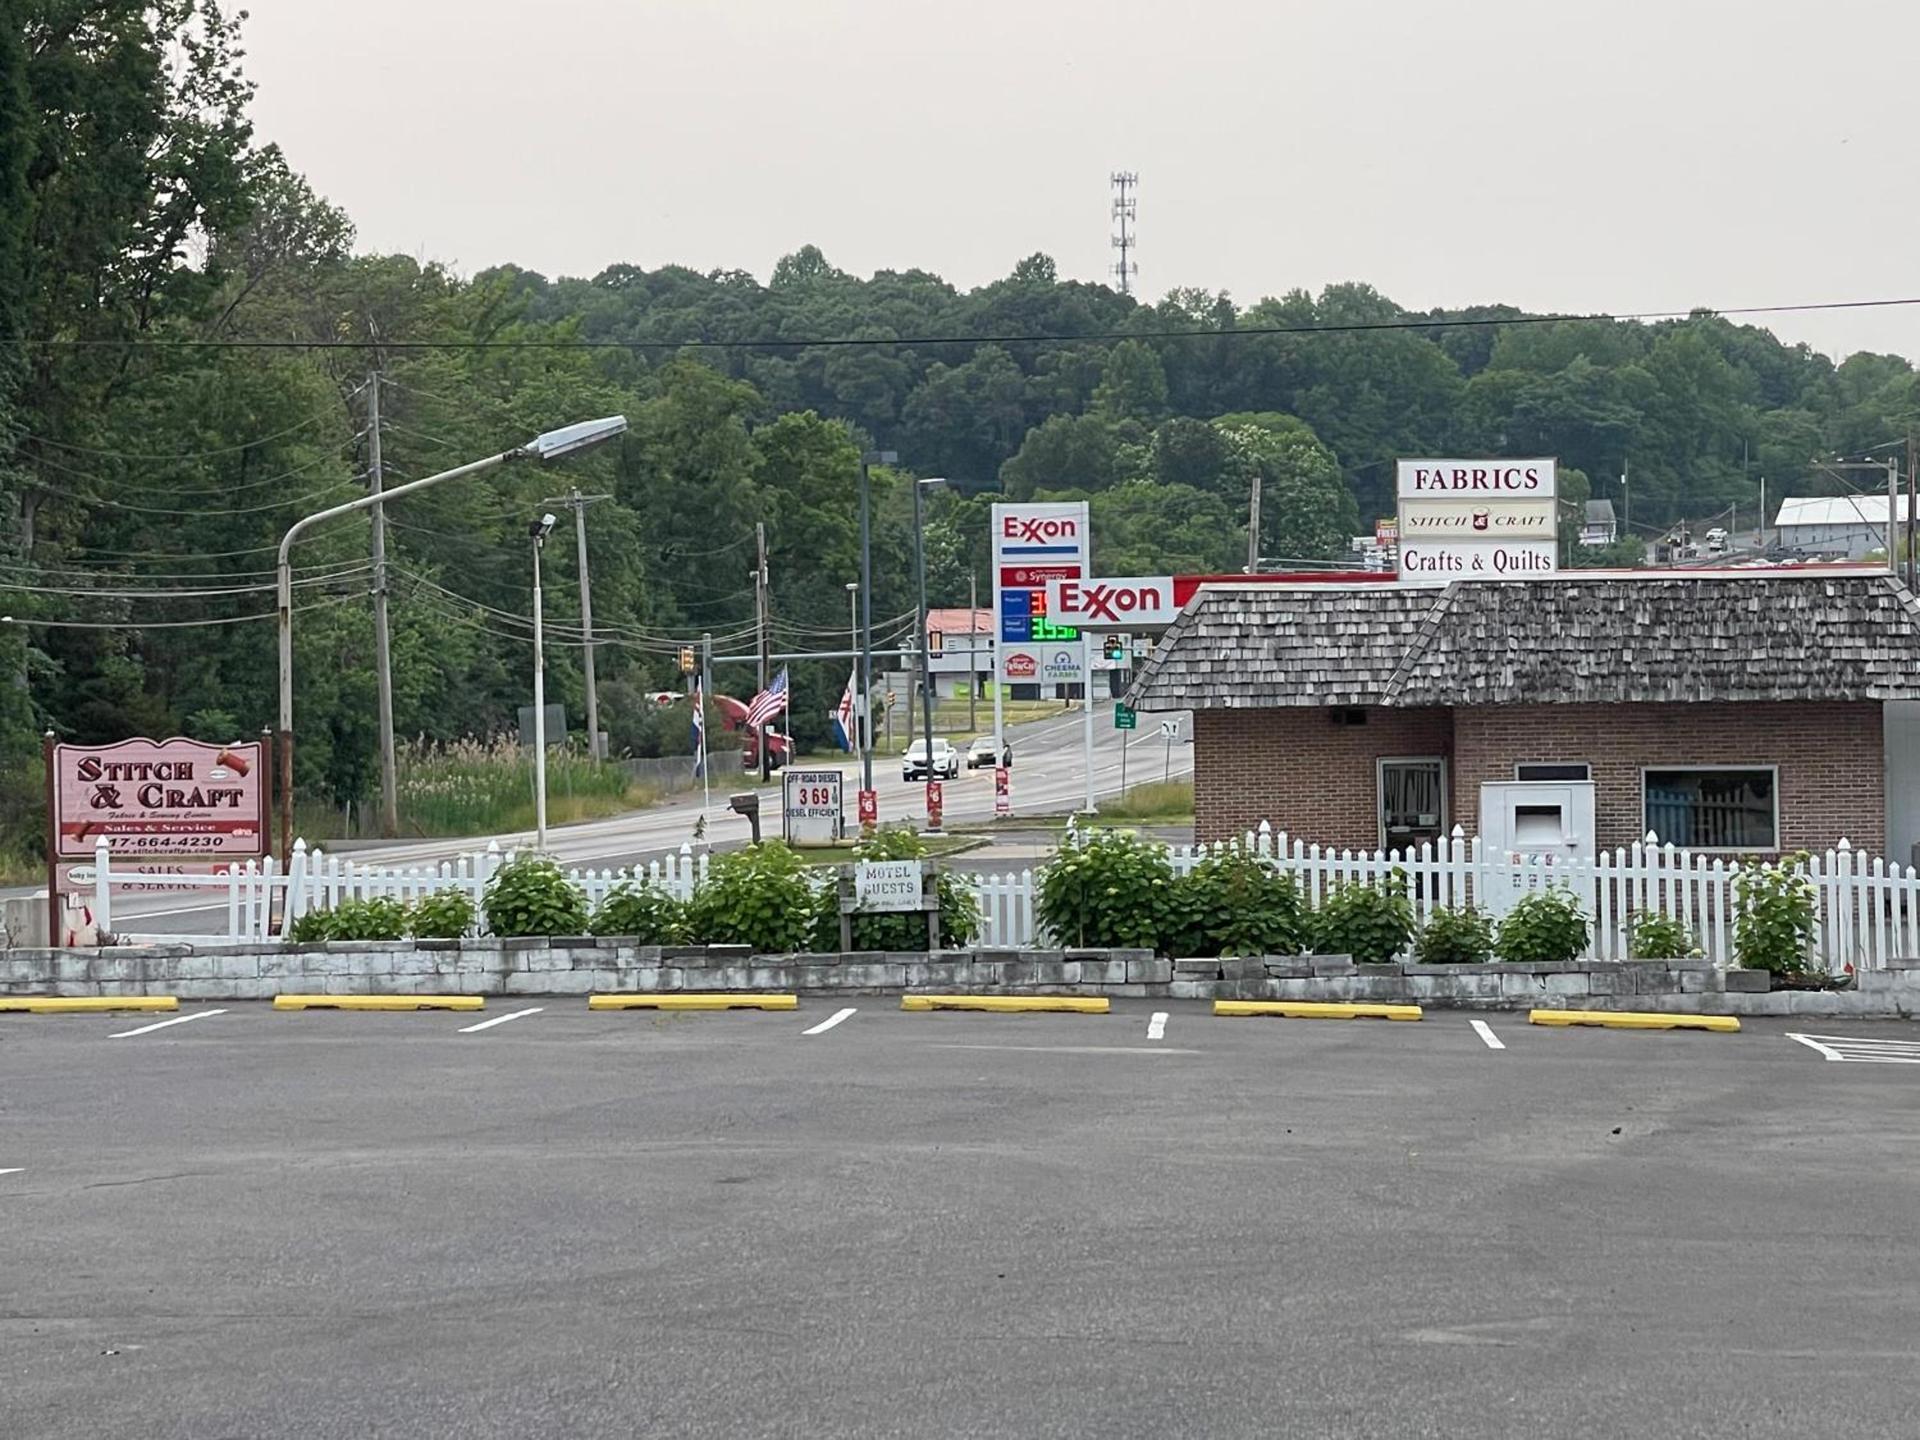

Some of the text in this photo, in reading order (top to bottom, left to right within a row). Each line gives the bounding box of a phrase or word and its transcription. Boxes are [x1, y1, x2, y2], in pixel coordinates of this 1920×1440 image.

[1415, 468, 1538, 490] FABRICS
[1004, 516, 1075, 544] Exxon
[1408, 516, 1467, 527] STITCH
[1495, 516, 1546, 526] CRAFT
[1404, 549, 1551, 573] Crafts & Quilts
[1060, 584, 1160, 622] Exxon
[77, 756, 194, 782] STITCH
[818, 774, 838, 782] DIESEL
[90, 783, 244, 809] & CRAFT
[103, 823, 216, 834] Sales & Service
[108, 836, 224, 847] 17-664-4230
[866, 866, 911, 879] MOTEL
[864, 882, 914, 895] GUESTS
